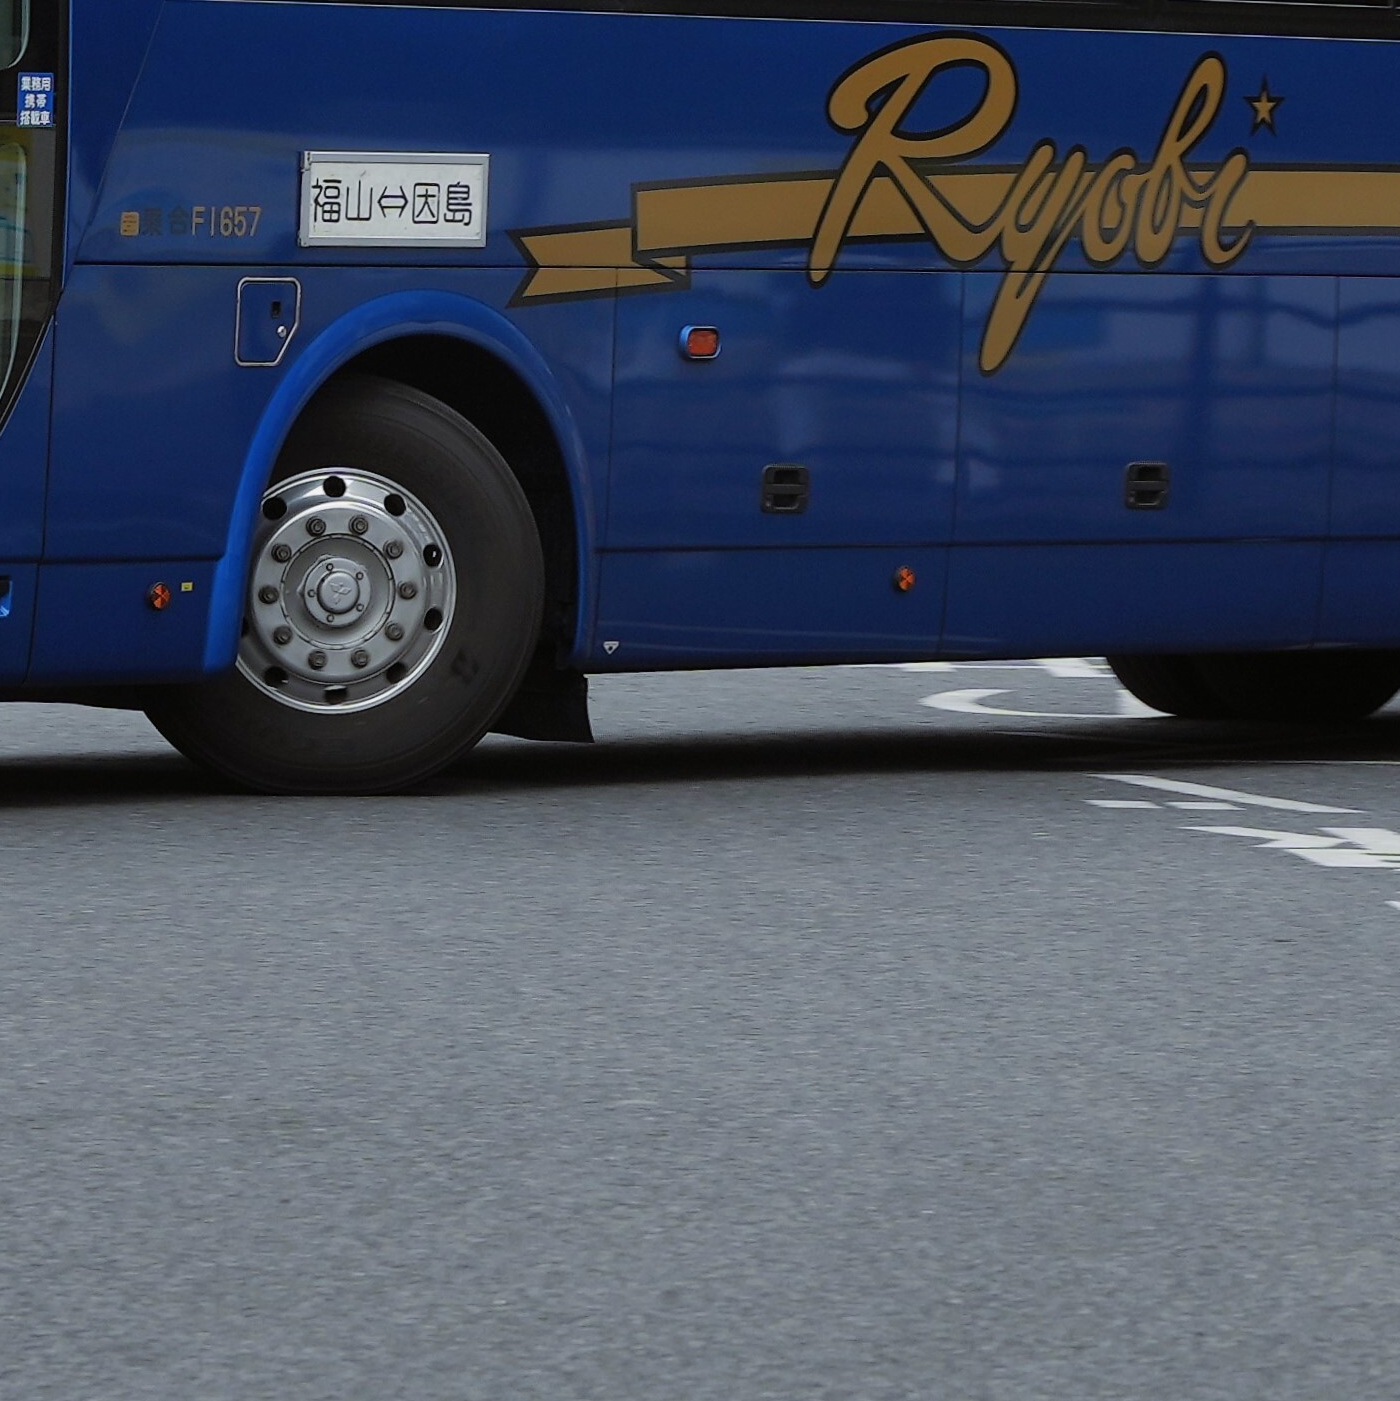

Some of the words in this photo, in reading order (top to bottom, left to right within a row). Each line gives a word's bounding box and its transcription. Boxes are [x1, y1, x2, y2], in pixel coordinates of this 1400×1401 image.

[21, 76, 51, 91] 業務用
[807, 29, 1259, 377] Ryobi
